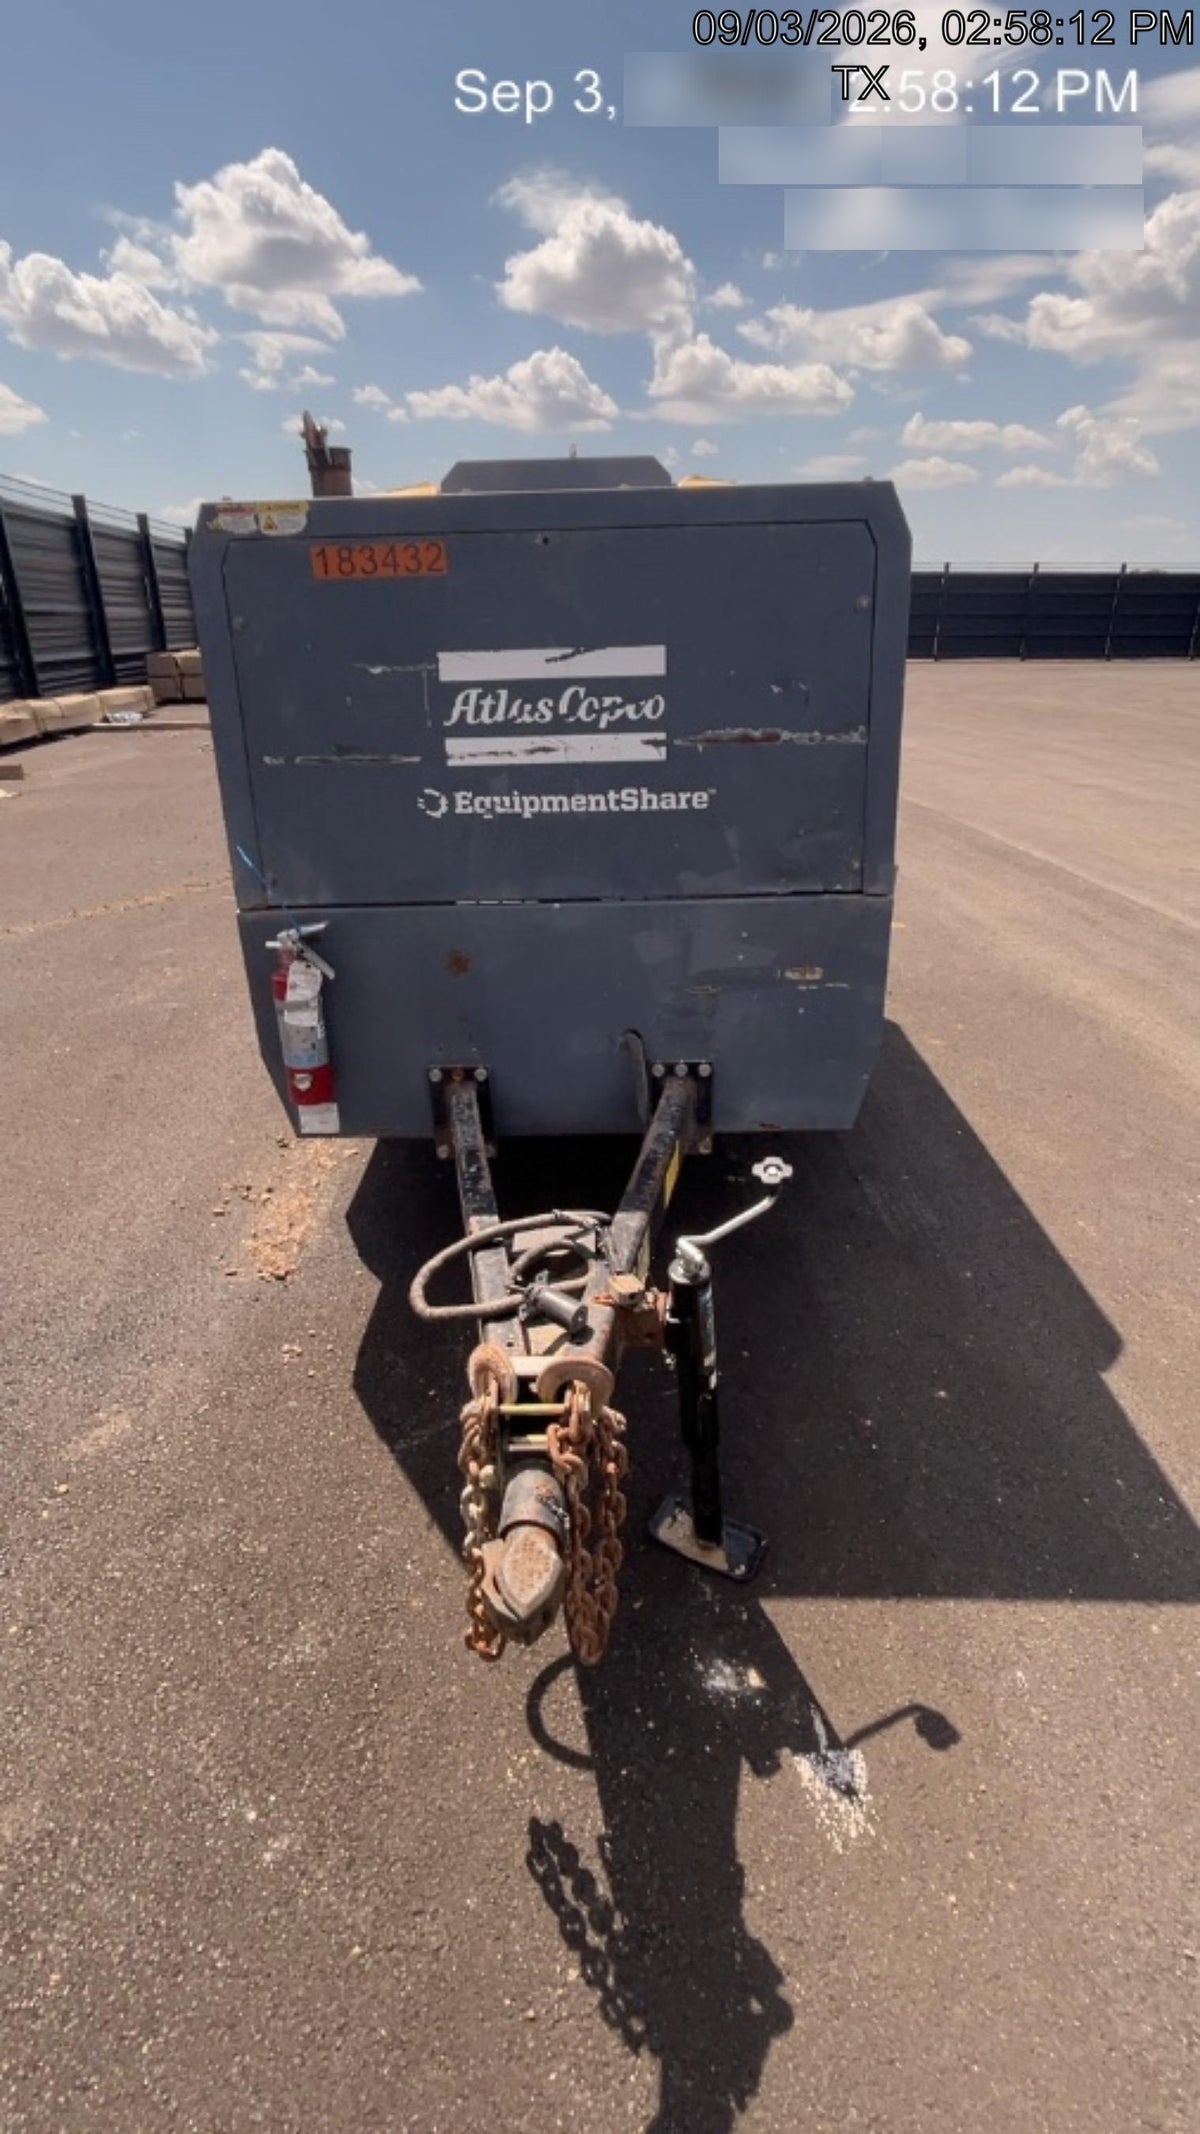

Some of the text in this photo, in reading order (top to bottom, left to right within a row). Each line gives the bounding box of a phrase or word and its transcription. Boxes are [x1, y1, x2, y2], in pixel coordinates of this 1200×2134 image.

[316, 541, 444, 577] 183432
[443, 687, 553, 726] Atlas
[453, 787, 710, 819] EquipmentShare
